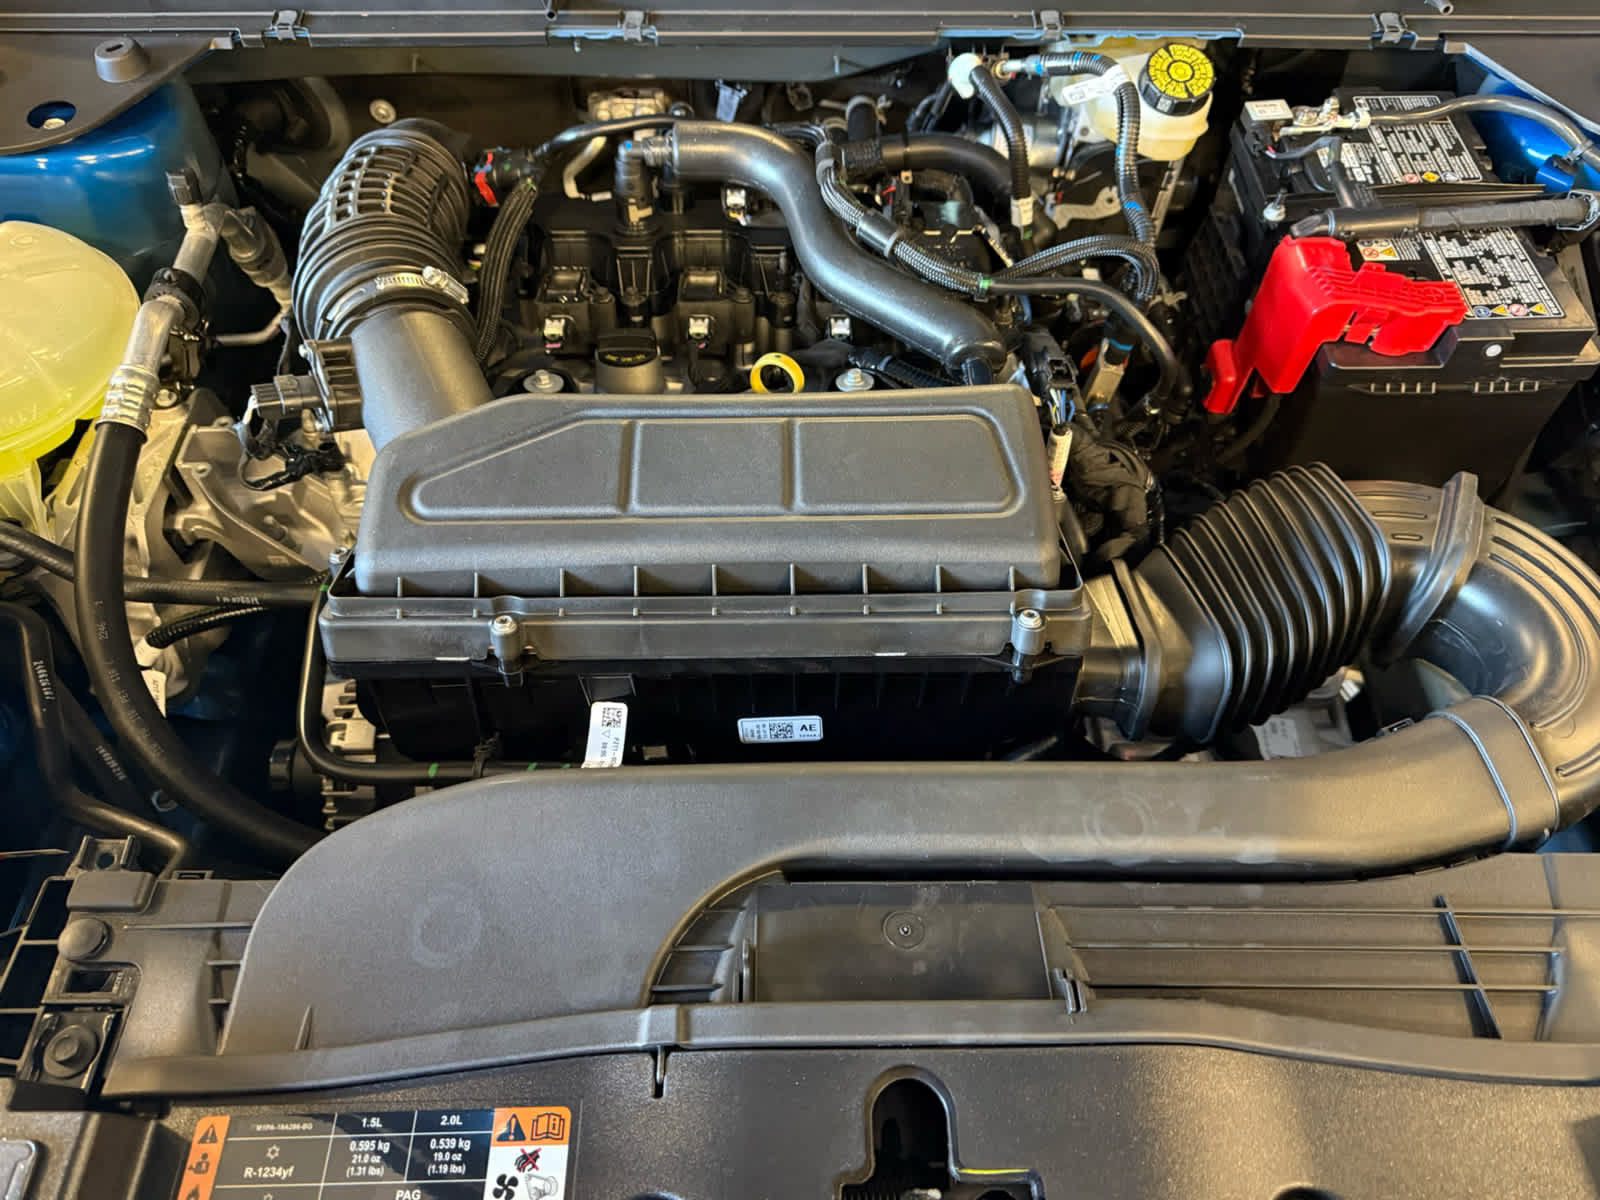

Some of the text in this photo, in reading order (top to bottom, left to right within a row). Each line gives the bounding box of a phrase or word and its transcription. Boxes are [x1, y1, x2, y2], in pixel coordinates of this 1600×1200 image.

[799, 723, 817, 732] AE
[361, 1117, 383, 1129] 1.5L
[440, 1114, 463, 1126] 2.0L
[348, 1140, 390, 1153] 0.595 kg
[430, 1137, 471, 1151] 0.539 kg
[371, 1154, 382, 1163] oz
[433, 1152, 463, 1161] 19.0 oz
[243, 1165, 295, 1180] R-1234yf
[427, 1165, 449, 1176] (1.19
[395, 1189, 422, 1200] PAG
